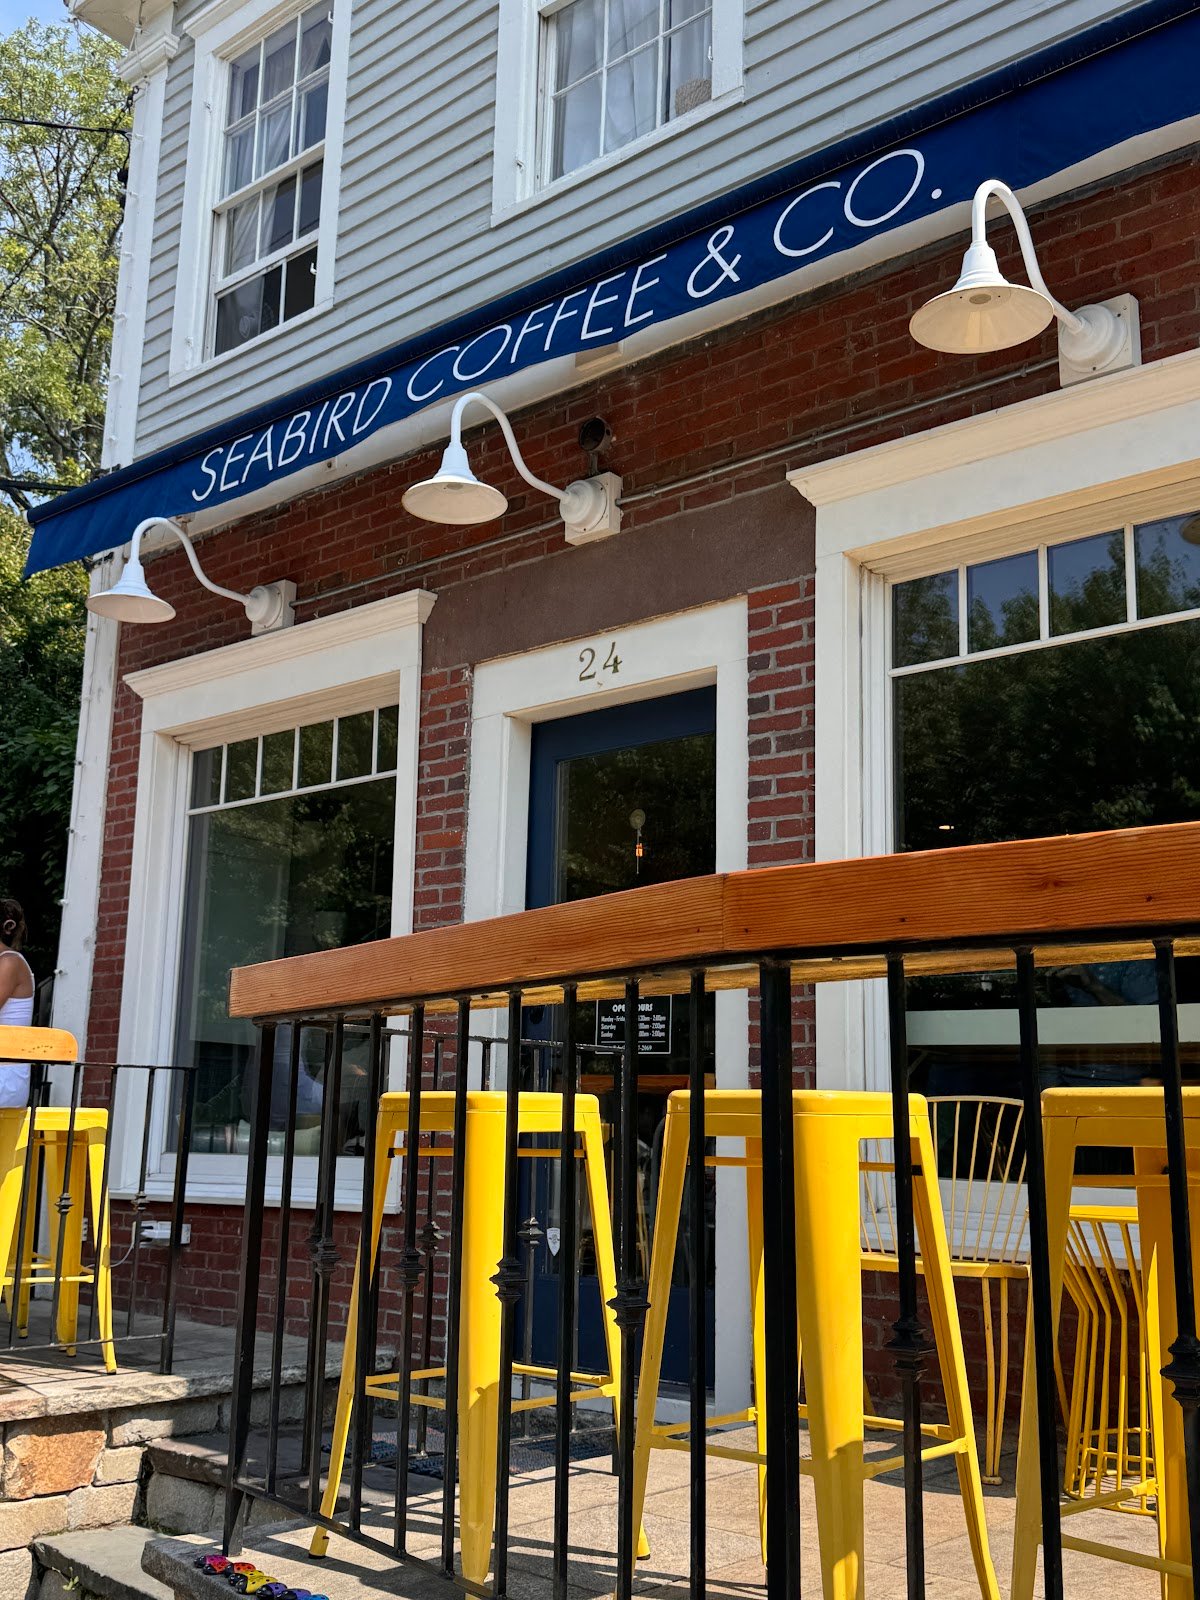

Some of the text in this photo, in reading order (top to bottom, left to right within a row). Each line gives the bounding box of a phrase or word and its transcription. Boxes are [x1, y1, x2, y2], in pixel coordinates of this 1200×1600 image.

[191, 148, 943, 501] SEABIRD COFFEE & CO.
[579, 641, 623, 682] 24
[612, 1003, 653, 1012] OPE OURS
